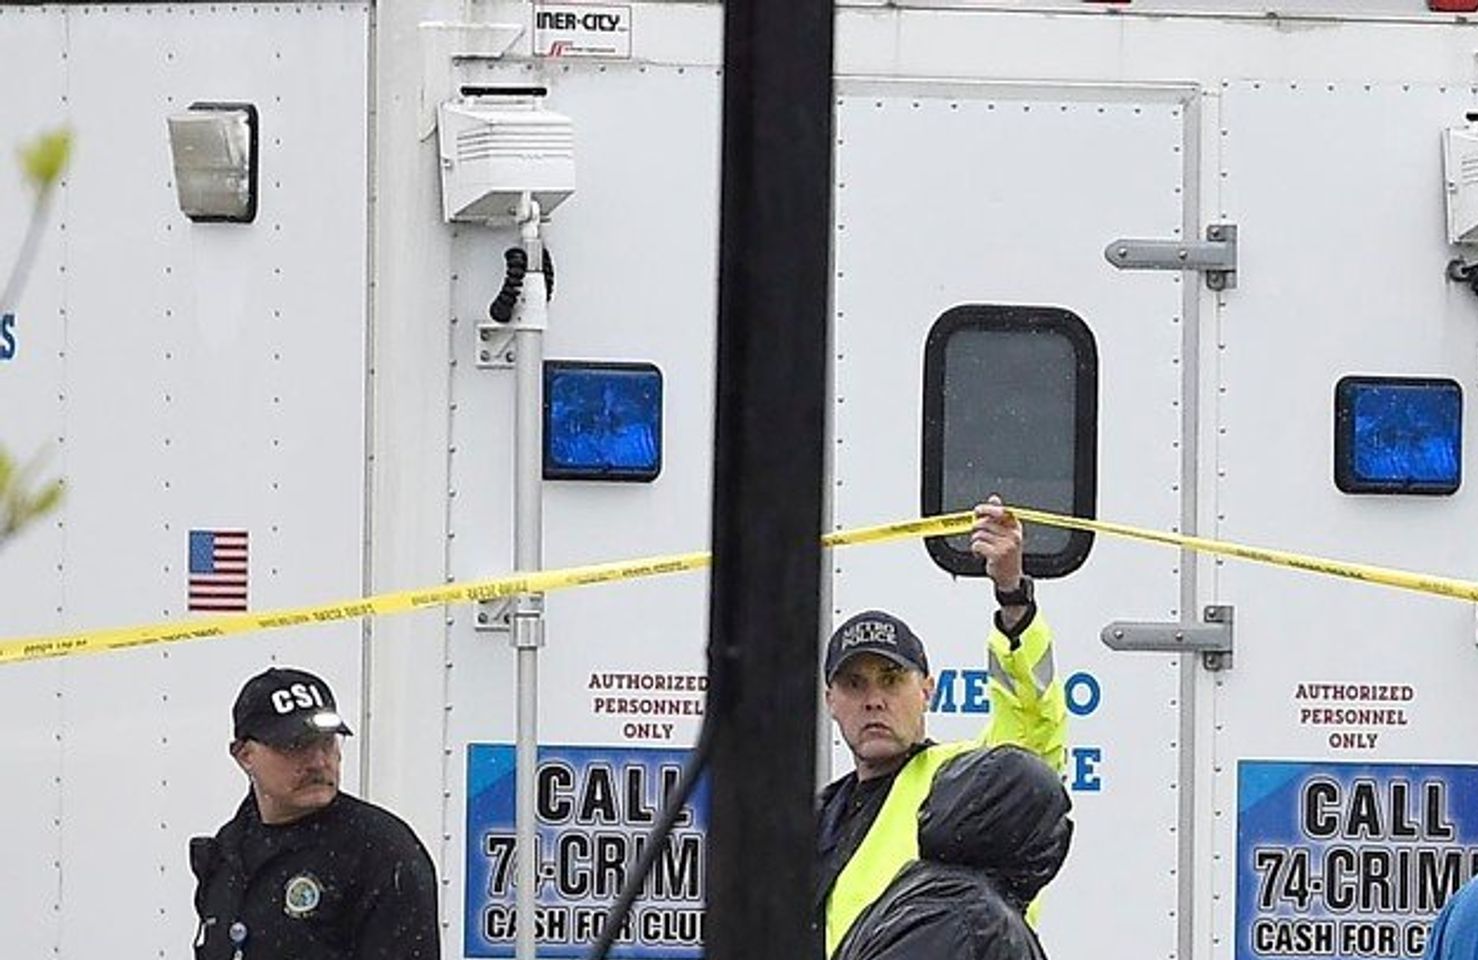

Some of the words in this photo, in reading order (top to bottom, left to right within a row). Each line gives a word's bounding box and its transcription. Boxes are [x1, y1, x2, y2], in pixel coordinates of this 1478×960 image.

[588, 673, 711, 692] AUTHORIZED
[930, 669, 1101, 717] MEO
[1296, 684, 1414, 701] AUTHORIZED
[271, 682, 323, 714] CSI
[593, 697, 704, 716] PERSONNEL
[1301, 708, 1408, 726] PERSONNEL
[623, 722, 675, 740] ONLY
[1328, 732, 1378, 749] ONLY
[536, 764, 689, 823] CALL
[1303, 780, 1452, 838] CALL
[642, 909, 705, 942] CLU
[1256, 922, 1333, 953] CASH
[1343, 923, 1396, 955] FOR
